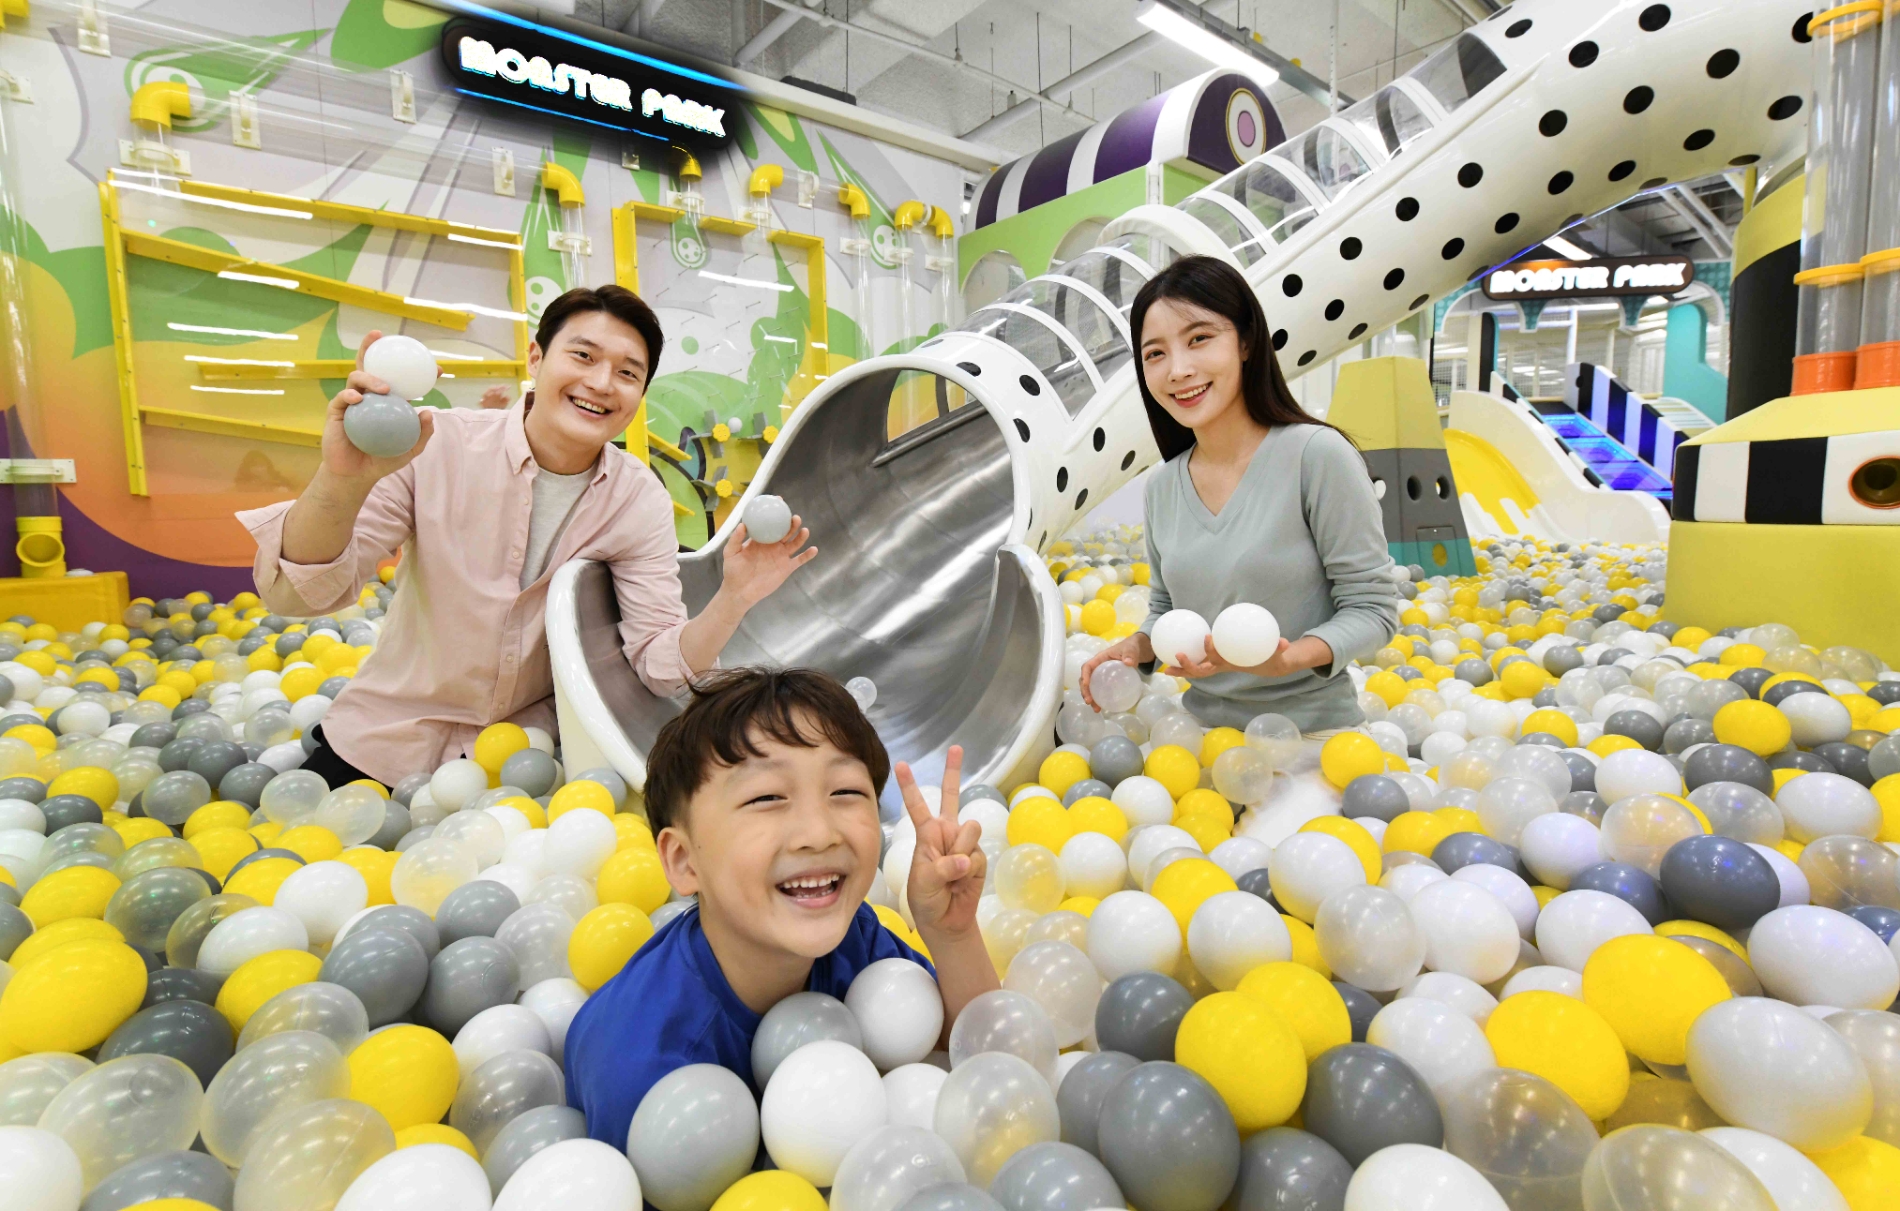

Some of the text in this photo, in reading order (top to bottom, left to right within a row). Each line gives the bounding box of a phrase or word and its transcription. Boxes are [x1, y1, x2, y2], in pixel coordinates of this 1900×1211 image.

[459, 36, 726, 137] MONSTER PARK
[1490, 263, 1686, 293] MONSTER PARK
